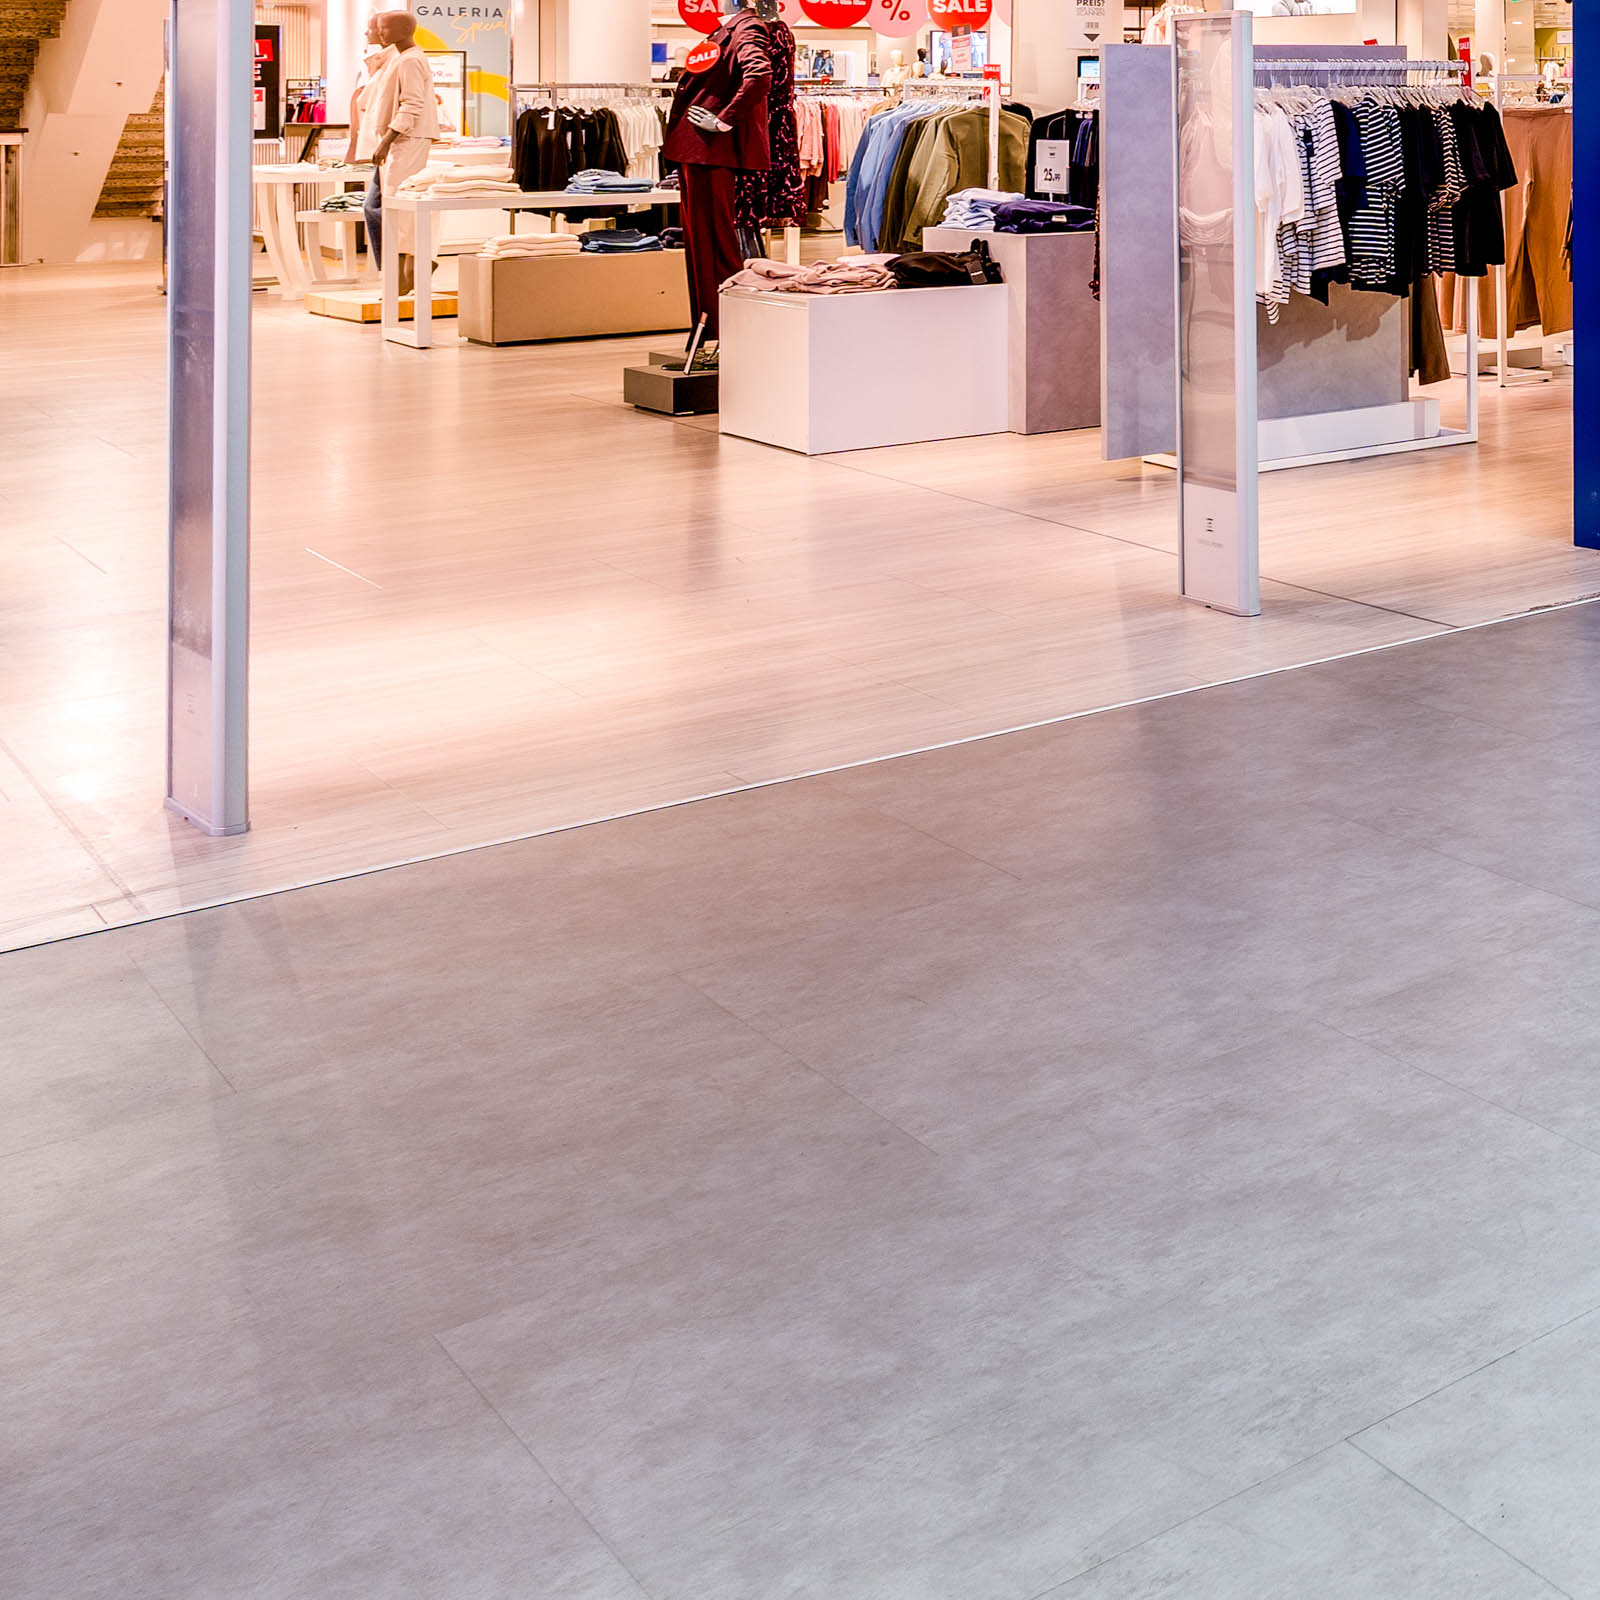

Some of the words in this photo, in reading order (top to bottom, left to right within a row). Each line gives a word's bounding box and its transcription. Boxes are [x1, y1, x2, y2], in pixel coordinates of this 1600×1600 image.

[1076, 0, 1106, 7] PREIS?
[416, 5, 504, 19] GALERIA
[687, 49, 718, 66] SALE
